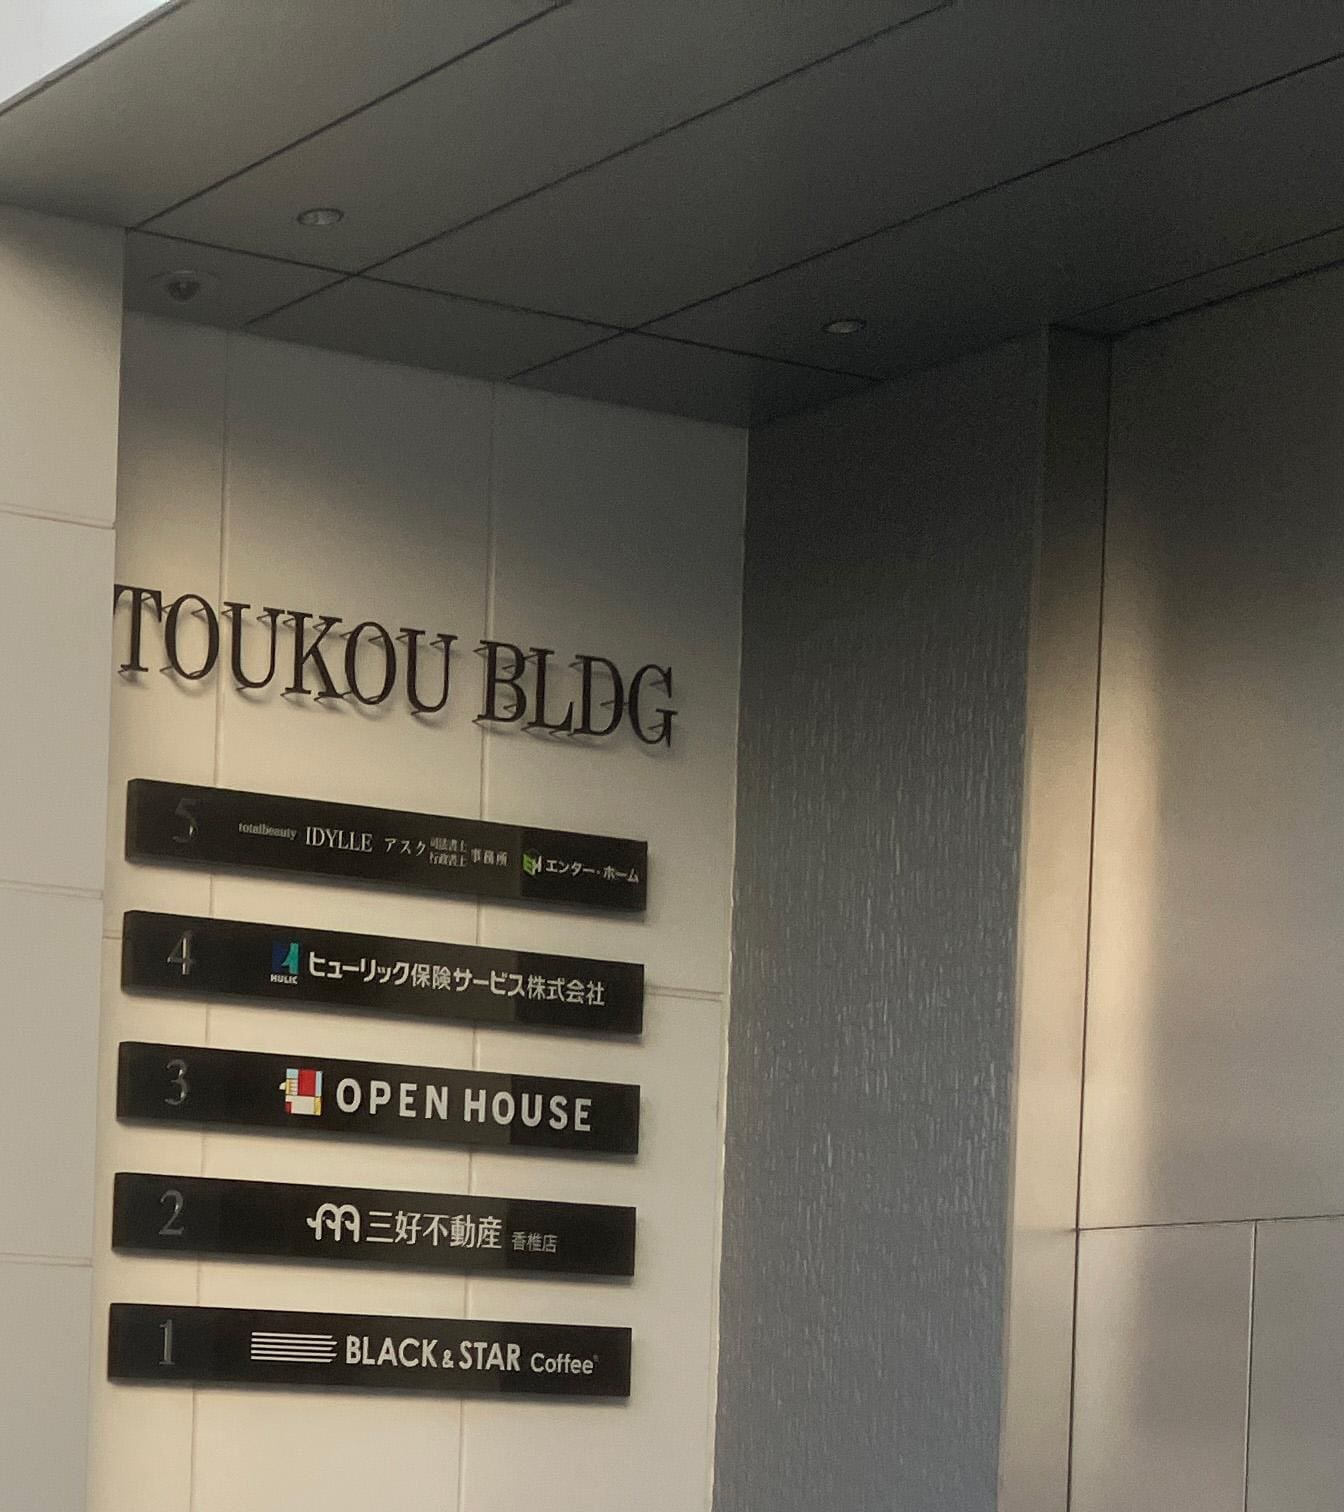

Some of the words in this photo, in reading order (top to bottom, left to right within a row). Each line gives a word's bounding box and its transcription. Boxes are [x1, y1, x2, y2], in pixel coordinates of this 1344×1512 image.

[113, 583, 457, 714] TOUKOU
[480, 639, 678, 748] BLDG
[173, 798, 198, 845] 5
[306, 826, 373, 854] IDYLLE
[384, 836, 427, 858] アスク
[470, 847, 508, 869] 事務所
[545, 859, 640, 884] エンター・ホーム
[167, 930, 193, 976] 4
[309, 951, 605, 1007] ヒューリック保険サービス株式会社
[165, 1058, 191, 1106] 3
[336, 1077, 449, 1120] OPEN
[464, 1088, 592, 1132] HOUSE
[159, 1189, 185, 1236] 2
[366, 1210, 503, 1250] 三好不動産
[511, 1231, 558, 1255] 香椎店
[159, 1319, 176, 1366] 1
[345, 1334, 437, 1369] BLACK
[442, 1350, 454, 1369] &
[459, 1341, 521, 1373] STAR
[530, 1352, 594, 1375] Coffee
